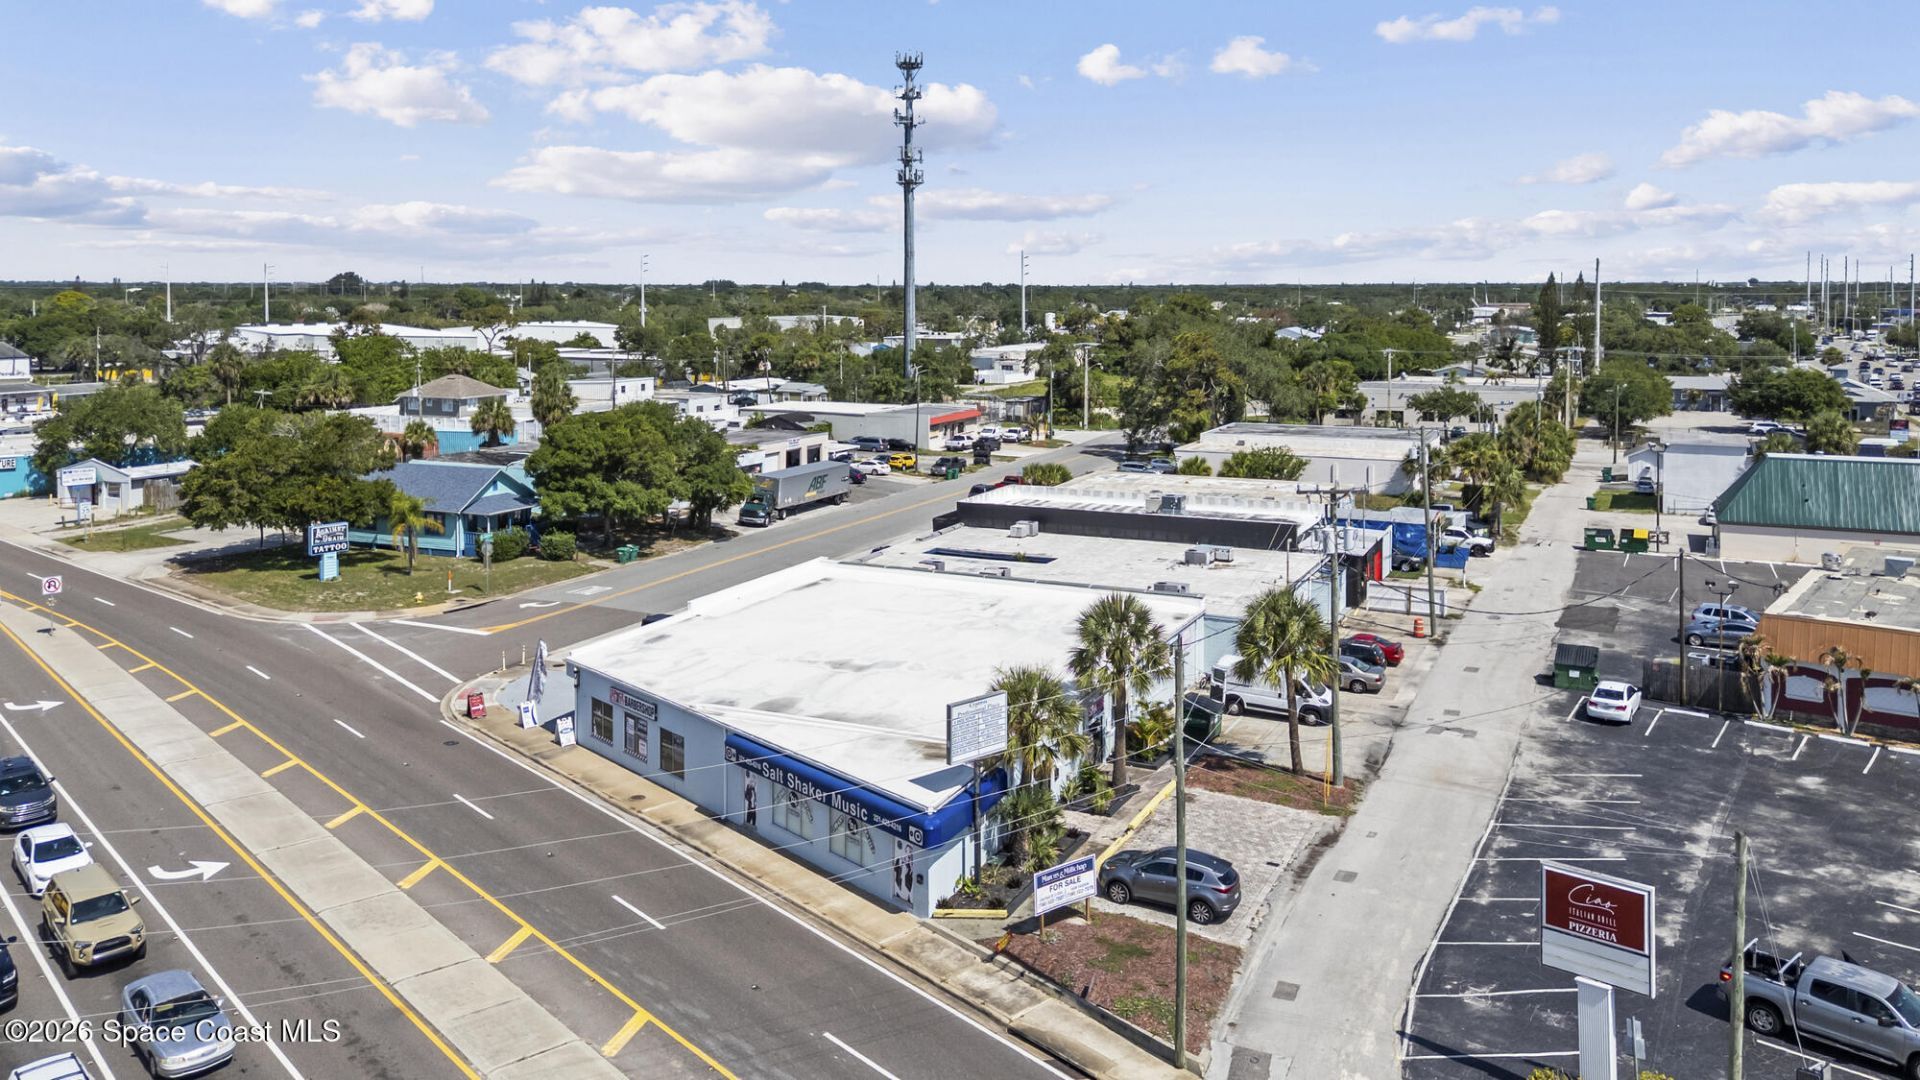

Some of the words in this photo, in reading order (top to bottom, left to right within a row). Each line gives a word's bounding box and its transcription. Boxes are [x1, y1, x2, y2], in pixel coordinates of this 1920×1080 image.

[808, 474, 828, 491] ABF
[313, 543, 347, 553] TATTOO
[762, 762, 784, 784] Salt
[787, 773, 826, 803] Shaker
[831, 791, 868, 821] Music
[1049, 881, 1063, 893] FOR
[1064, 875, 1082, 887] SALE
[1568, 884, 1618, 915] Ciao
[1568, 920, 1618, 943] PIZZERIA
